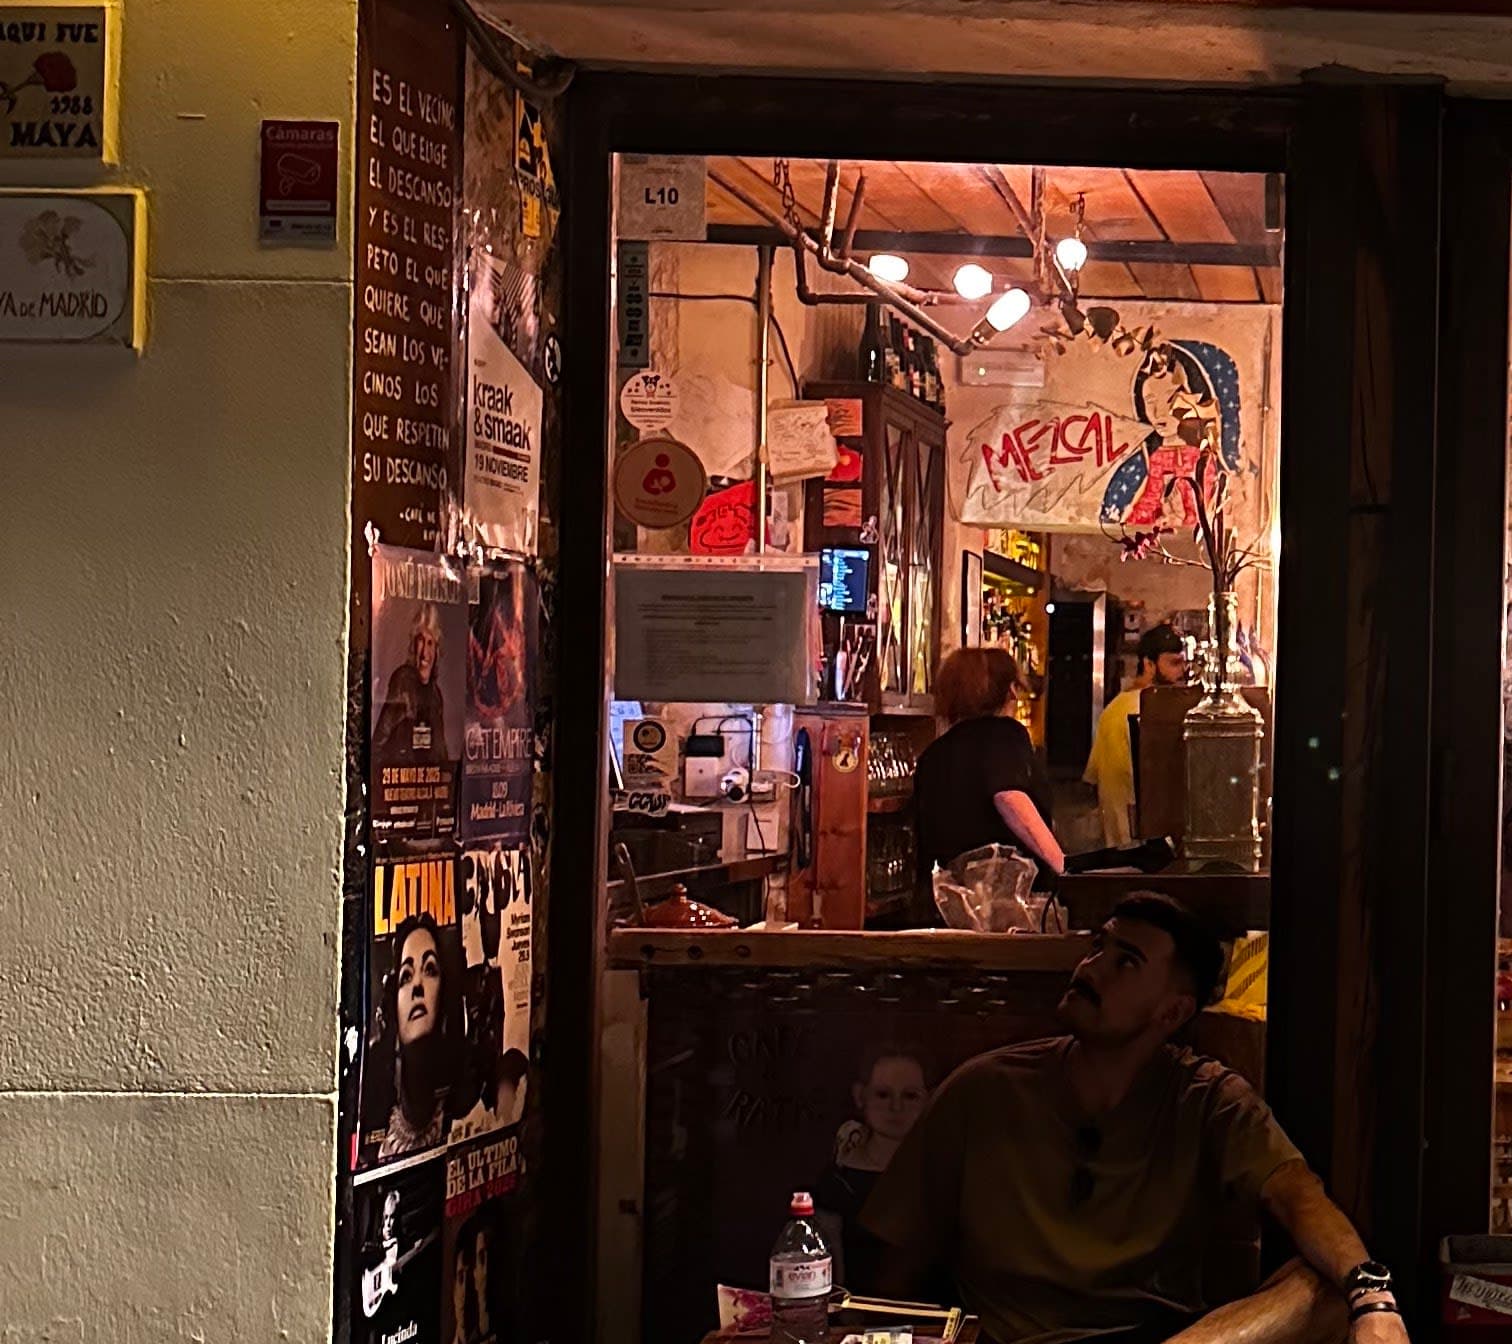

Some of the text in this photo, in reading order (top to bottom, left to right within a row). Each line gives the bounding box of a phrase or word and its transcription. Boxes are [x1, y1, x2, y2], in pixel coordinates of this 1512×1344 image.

[55, 23, 99, 43] FUE
[372, 68, 392, 105] ES
[399, 81, 413, 116] EL
[10, 122, 98, 147] MAYA
[265, 125, 335, 144] Cámaras
[370, 114, 385, 148] EL
[392, 126, 416, 160] QUE
[369, 157, 451, 208] EL DESCANSO
[644, 187, 680, 205] L10
[368, 206, 378, 227] Y
[383, 210, 399, 236] ES
[404, 213, 417, 244] EL
[367, 243, 448, 291] PETO EL QUE
[364, 285, 444, 331] QUIERE QUE
[364, 327, 397, 357] SEAN
[403, 335, 425, 367] LOS
[363, 370, 439, 408] CINOS LOS
[473, 374, 513, 414] kraak
[363, 412, 389, 441] QUE
[474, 407, 531, 452] & smaak
[363, 452, 381, 483] SU
[386, 457, 448, 492] DESCANSO
[485, 457, 529, 483] NOVIEMBRE
[981, 412, 1129, 493] MEZCAL
[493, 727, 532, 759] EMPIRE
[374, 859, 457, 936] LATINA
[446, 1158, 464, 1181] EL
[446, 1154, 519, 1201] DE LA FILA
